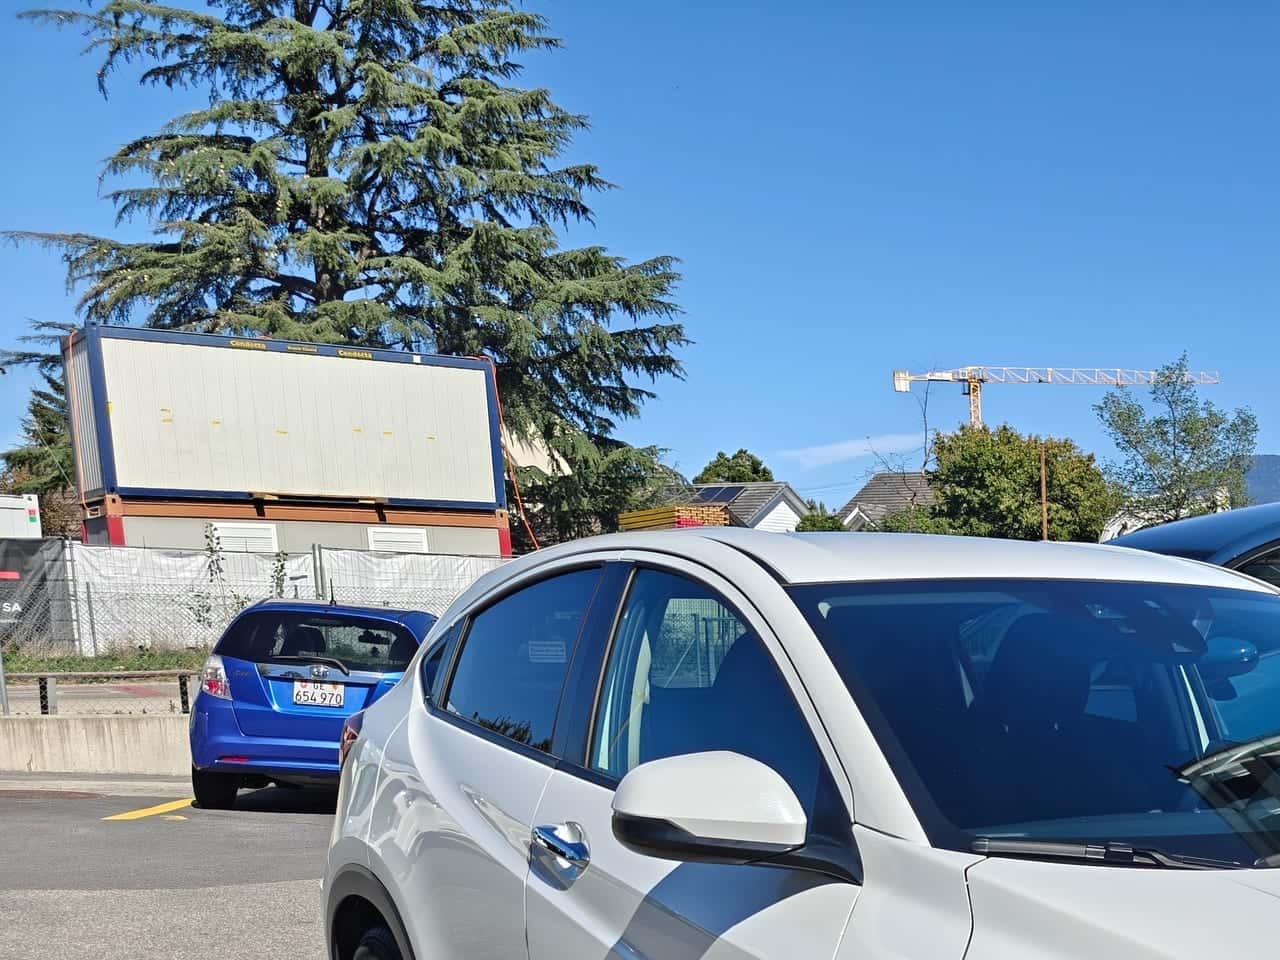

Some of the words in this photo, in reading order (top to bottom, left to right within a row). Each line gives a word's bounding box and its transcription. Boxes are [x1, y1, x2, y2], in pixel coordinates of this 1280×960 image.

[2, 602, 22, 613] SA
[313, 682, 325, 691] GE
[295, 690, 317, 702] 654
[320, 692, 342, 705] 970
